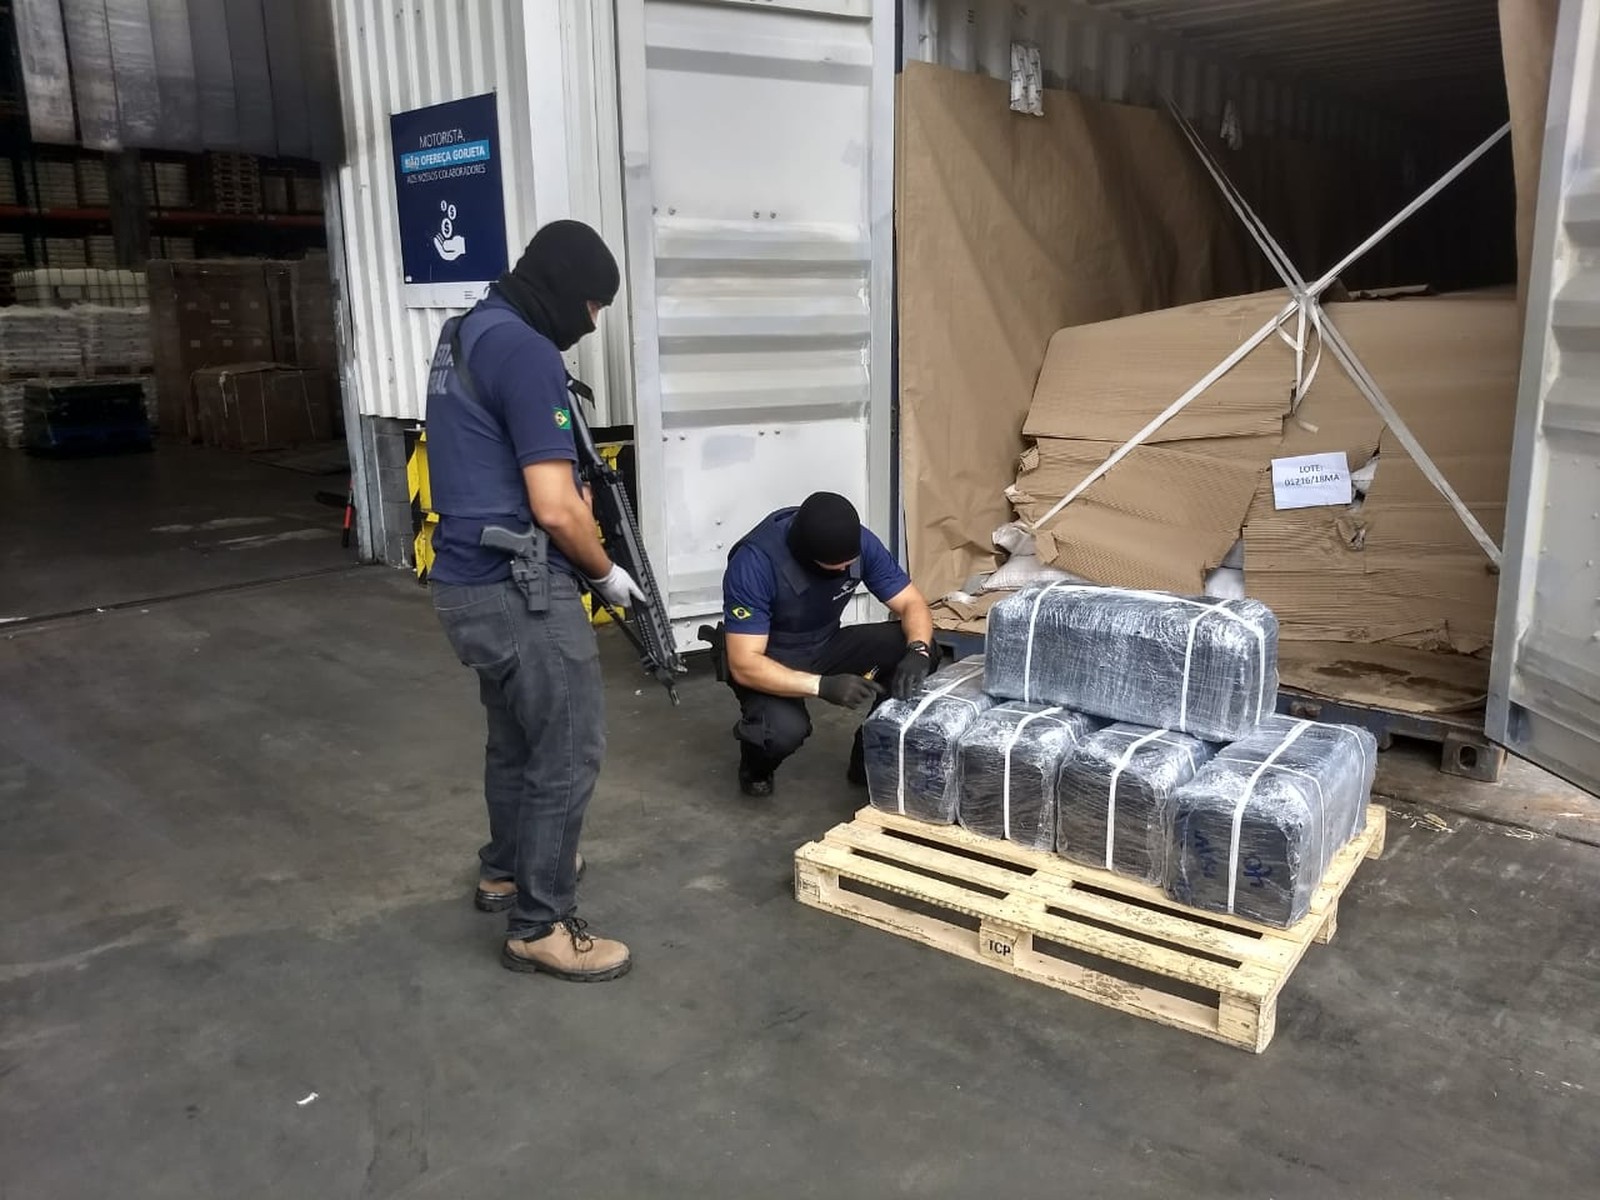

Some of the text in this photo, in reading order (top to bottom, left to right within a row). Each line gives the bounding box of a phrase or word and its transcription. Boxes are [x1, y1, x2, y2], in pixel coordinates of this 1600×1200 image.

[420, 151, 452, 167] OFEREÇA
[452, 146, 486, 161] GORJETA
[438, 164, 486, 180] COLABORADORES
